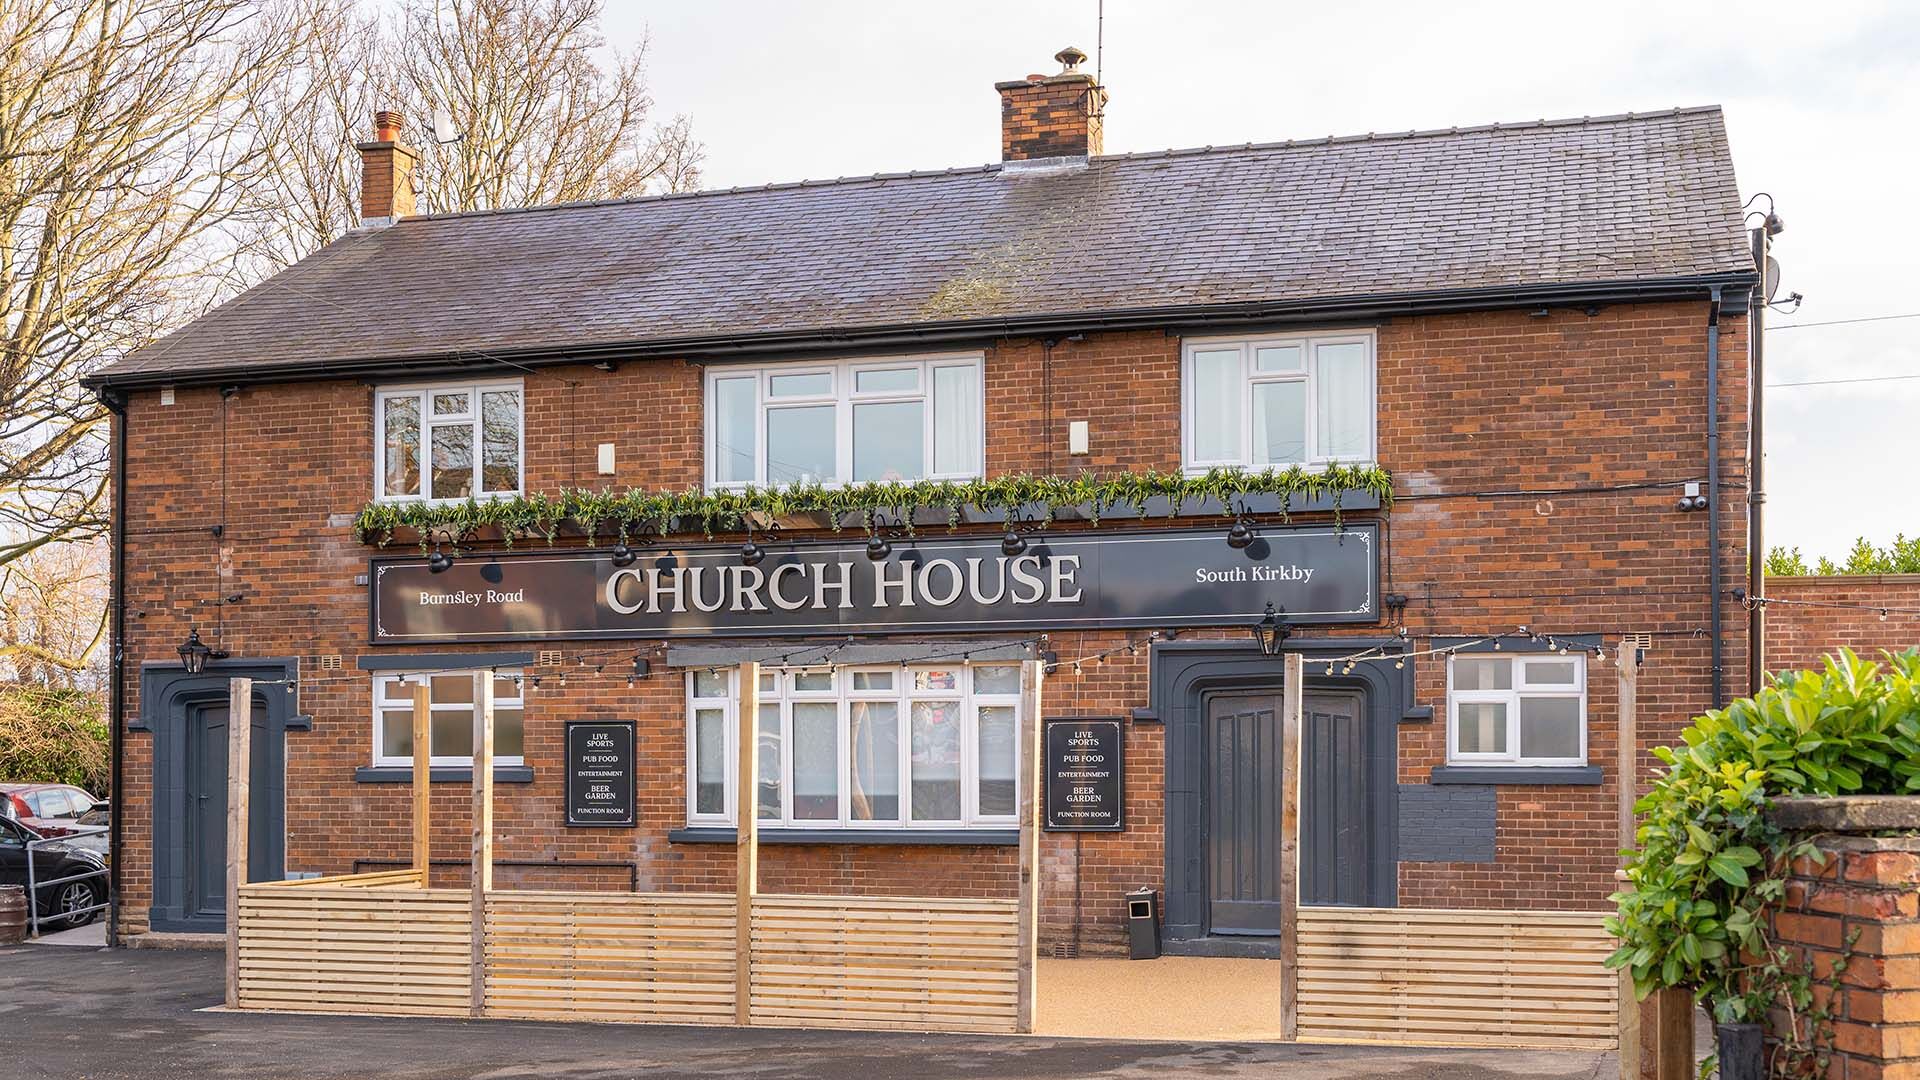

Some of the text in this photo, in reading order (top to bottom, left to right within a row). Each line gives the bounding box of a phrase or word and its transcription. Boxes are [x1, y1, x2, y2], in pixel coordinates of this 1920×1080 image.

[1195, 564, 1315, 584] South Kirkby
[605, 554, 1084, 614] CHURCH HOUSE
[419, 588, 524, 608] Barnsley Road
[1068, 738, 1100, 746] SPORTS
[585, 792, 616, 800] GARDEN
[1066, 794, 1102, 802] GARDEN
